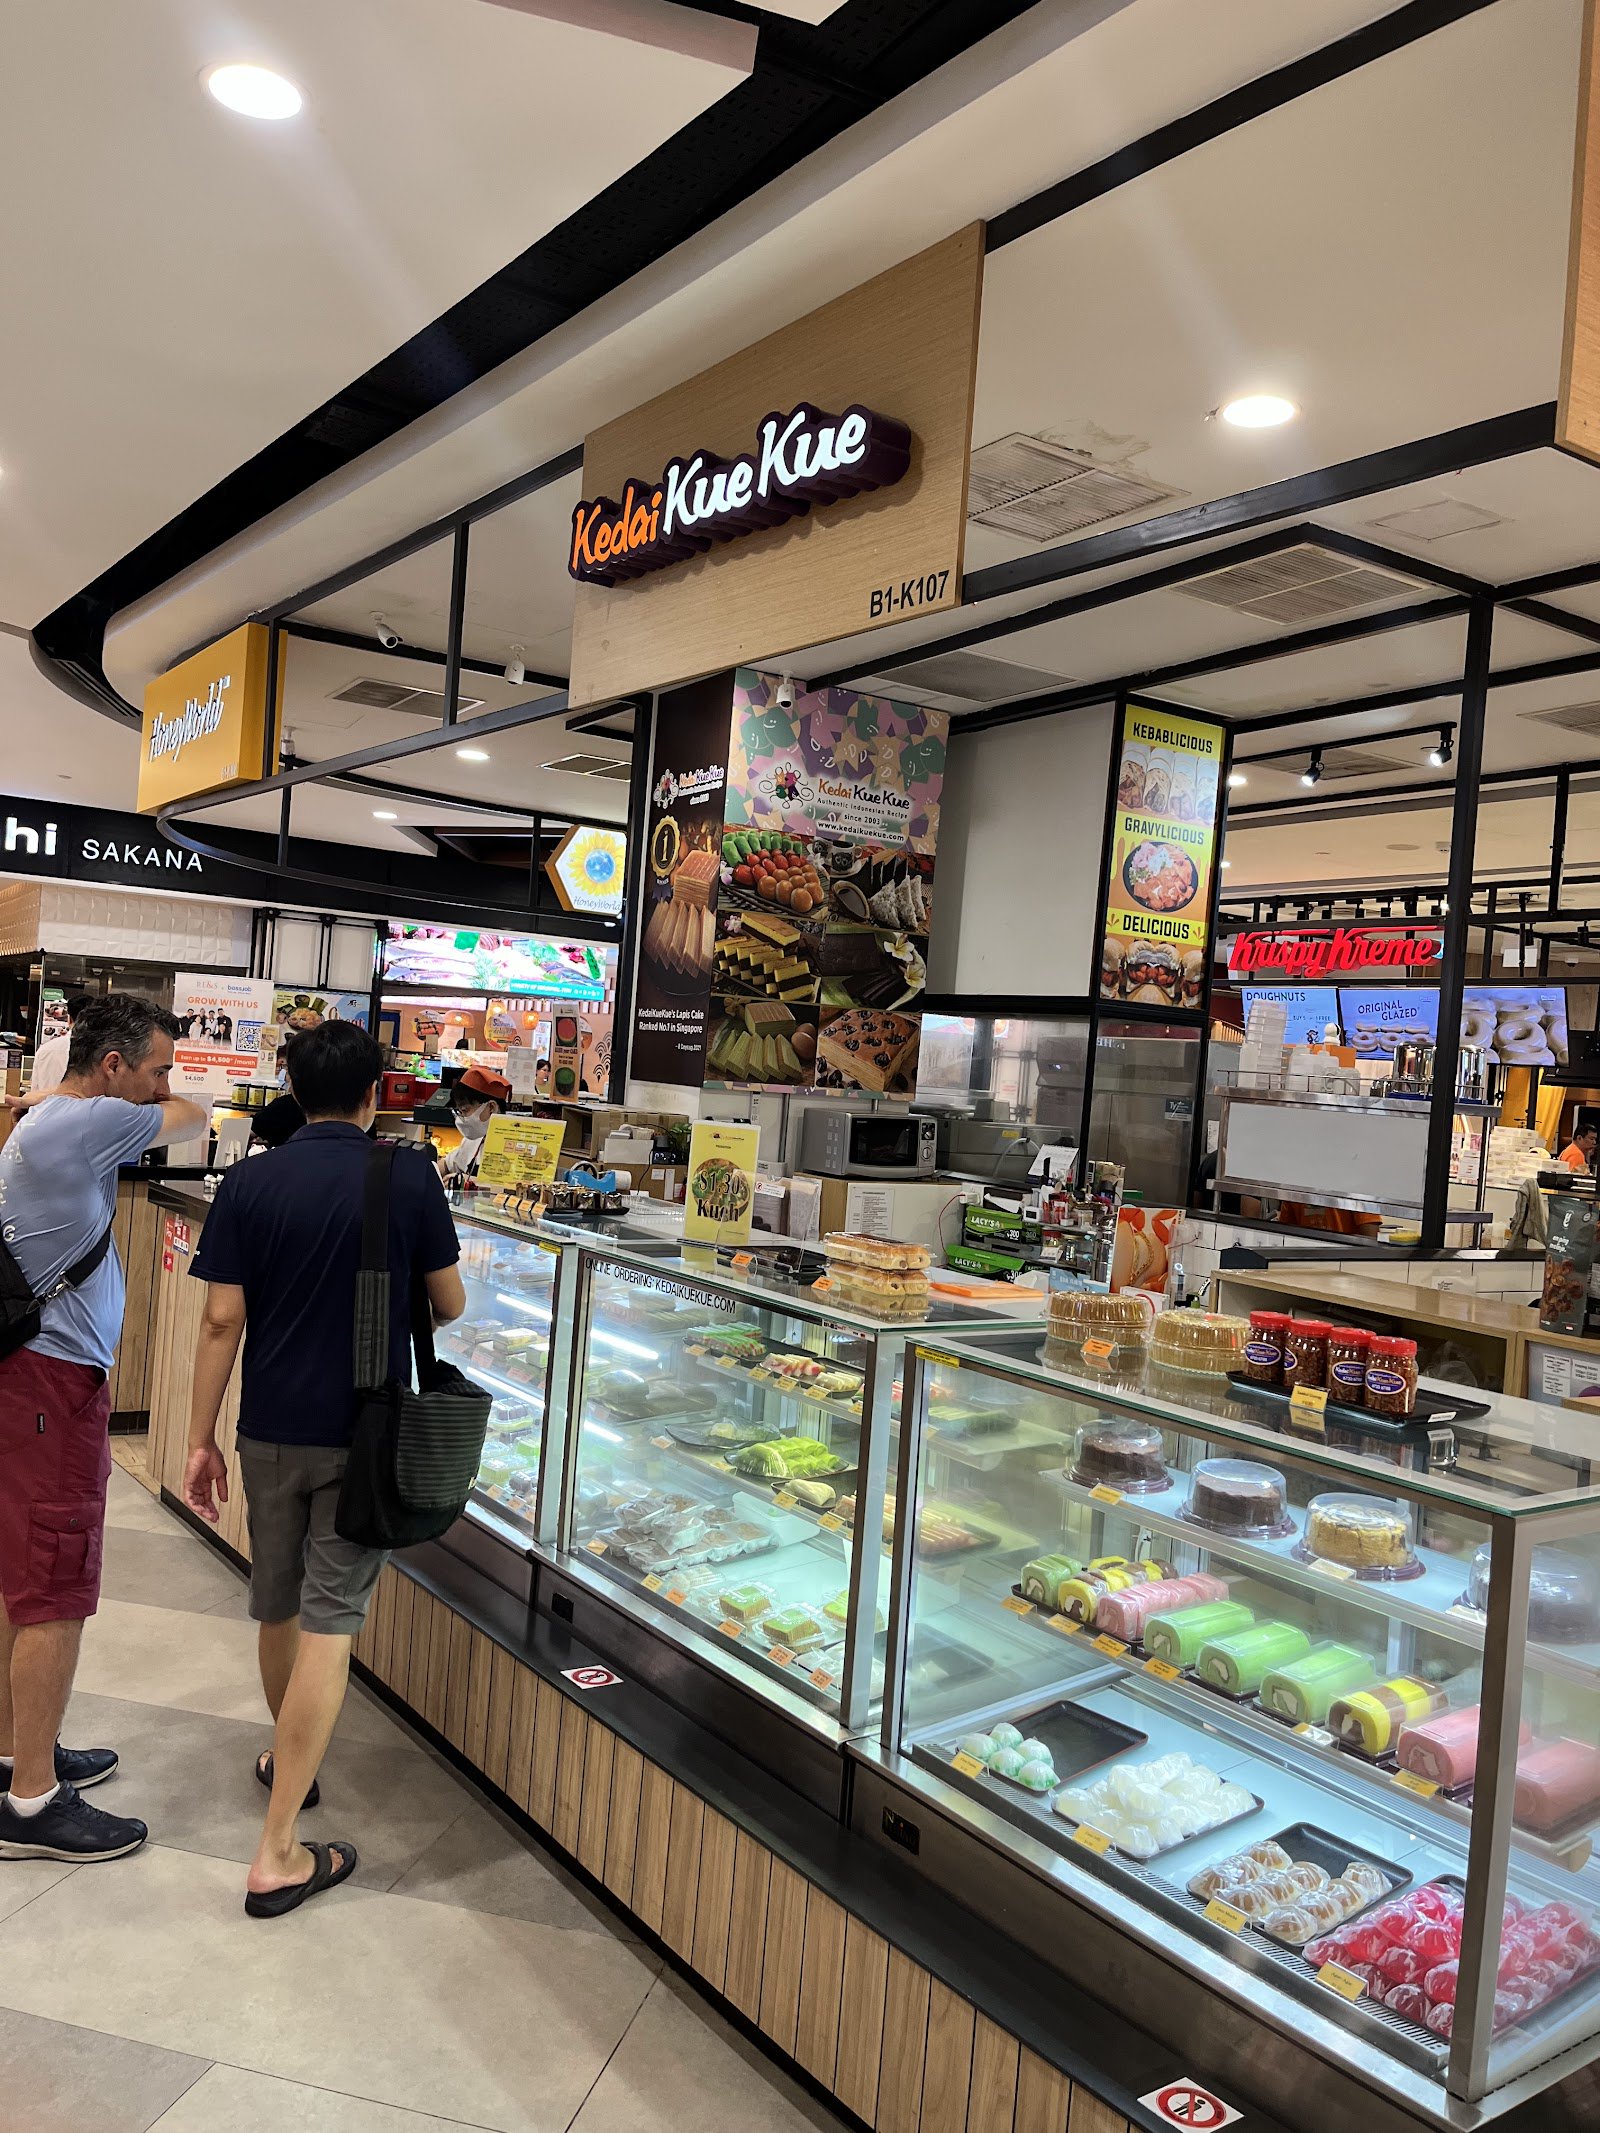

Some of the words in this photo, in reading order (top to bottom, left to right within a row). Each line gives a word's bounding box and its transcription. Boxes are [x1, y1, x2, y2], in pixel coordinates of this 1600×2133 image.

[869, 570, 950, 618] B1-K107
[1132, 721, 1213, 753] KEBABLICIOUS
[844, 813, 862, 822] since
[864, 816, 881, 826] 2003
[817, 821, 905, 842] www.kedaikuekue.com
[1124, 816, 1205, 845] GRAVYLICIOUS
[82, 838, 203, 872] SAKANA
[1122, 914, 1190, 940] DELICIOUS
[1228, 929, 1330, 977] Krispy
[1325, 926, 1438, 971] Kreme
[187, 996, 218, 1005] GROW
[220, 998, 245, 1008] WITH
[246, 1001, 259, 1009] US
[1246, 992, 1306, 1002] DOUGHNUTS
[1357, 999, 1402, 1014] ORIGINAL
[676, 1010, 691, 1020] Lapis
[691, 1010, 704, 1020] Cake
[1381, 1008, 1418, 1021] GLAZED
[639, 1021, 658, 1031] Ranked
[658, 1022, 670, 1032] No.1
[670, 1023, 676, 1032] in
[676, 1023, 703, 1034] Singapore
[234, 1058, 256, 1066] /month
[971, 1216, 995, 1228] LACY'S
[585, 1257, 611, 1276] ONLINE
[655, 1278, 736, 1314] KEDAIKUEKUE.COM
